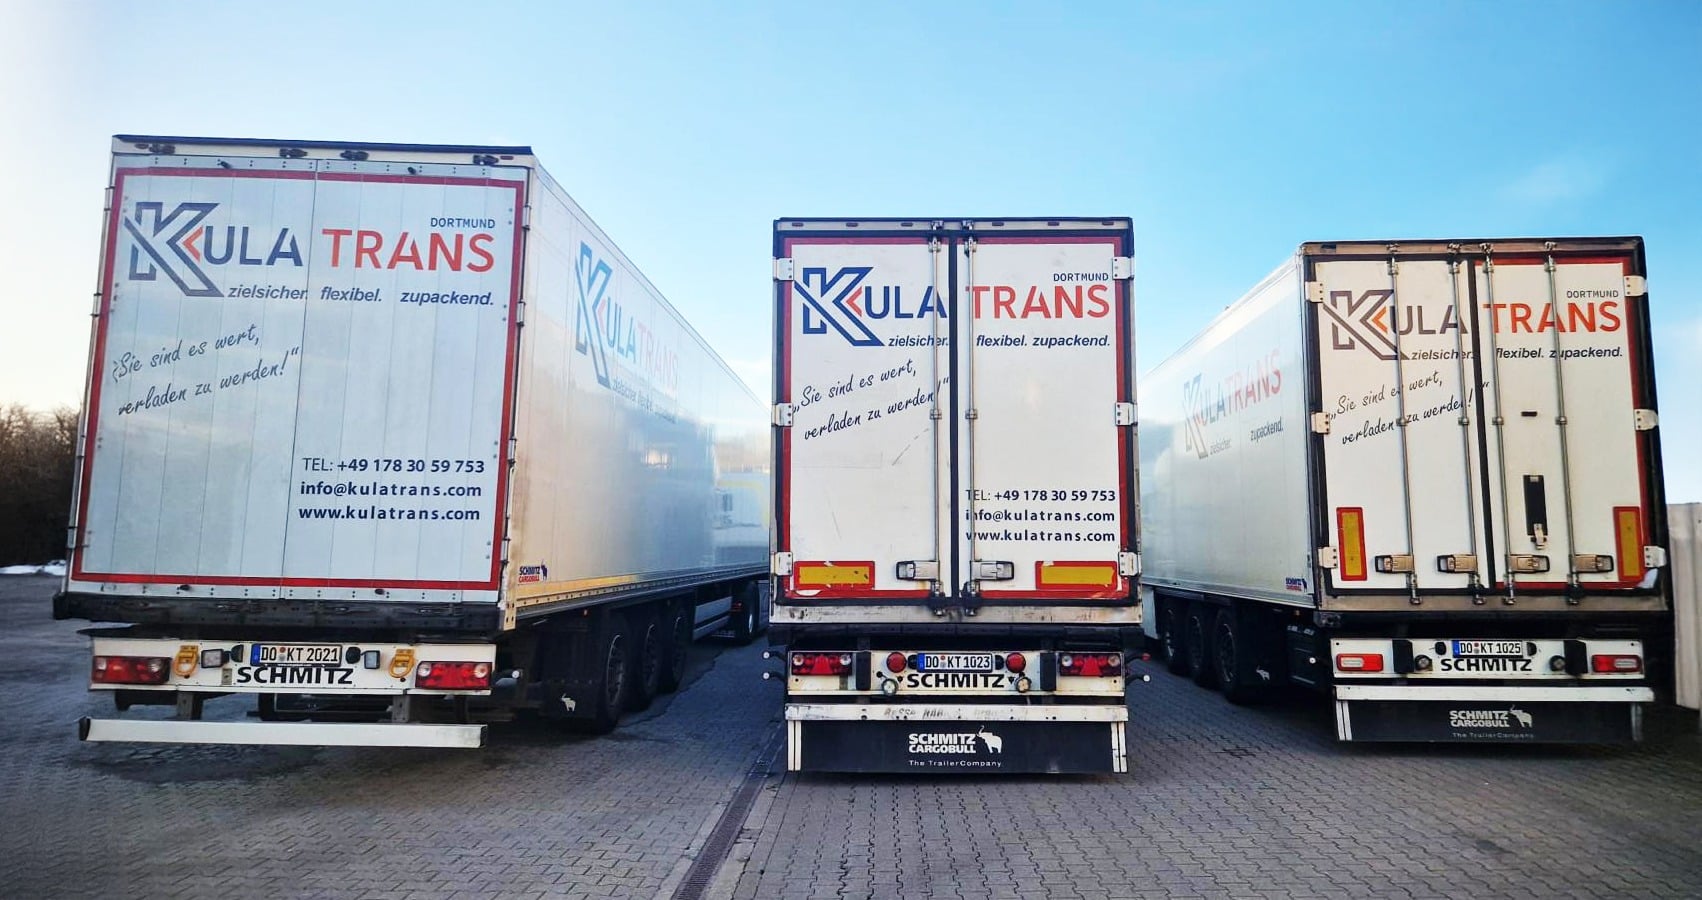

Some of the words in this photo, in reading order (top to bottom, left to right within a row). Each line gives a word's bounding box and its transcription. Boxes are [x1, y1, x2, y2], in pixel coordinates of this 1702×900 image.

[430, 216, 496, 229] DORTMUND
[321, 228, 495, 272] TRANS
[1053, 272, 1109, 282] DORTMUND
[228, 285, 308, 300] zielsicher.
[321, 285, 382, 302] flexibel.
[400, 289, 494, 306] zupackend.
[965, 284, 1110, 319] TRANS
[1566, 290, 1619, 299] DORTMUND
[1483, 301, 1621, 334] TRANS
[150, 339, 183, 368] sind
[188, 340, 208, 357] es
[215, 323, 260, 350] wert,
[888, 335, 949, 347] zielsicher.
[976, 334, 1028, 347] flexibel.
[1032, 334, 1110, 348] zupackend.
[1496, 347, 1544, 359] flexibel.
[828, 374, 854, 398] sind
[859, 374, 874, 388] es
[880, 358, 916, 381] wert,
[1362, 384, 1385, 407] sind
[1390, 384, 1404, 397] e
[1409, 369, 1443, 391] wert,
[118, 383, 188, 416] verladen
[195, 383, 213, 396] zu
[804, 410, 861, 440] verladen
[867, 408, 882, 421] zu
[1342, 417, 1395, 445] verladen
[1405, 414, 1418, 424] zu
[302, 457, 334, 472] TEL:
[337, 458, 368, 473] +49
[373, 458, 402, 473] 178
[407, 459, 426, 473] 30
[431, 459, 451, 473] 59
[455, 460, 485, 474] 753
[300, 480, 482, 498] info@kulatrans.com
[965, 489, 991, 501] TEL:
[994, 490, 1020, 501] +49
[1024, 490, 1048, 501] 178
[1051, 490, 1067, 501] 30
[1071, 490, 1088, 501] 59
[1091, 490, 1116, 501] 753
[298, 505, 480, 520] www.kulatrans.com
[965, 509, 1115, 522] info@kulatrans.com
[965, 529, 1116, 541] www.kulatrans.com
[261, 646, 278, 661] DO
[287, 647, 303, 661] KT
[307, 647, 338, 662] 2021
[1460, 642, 1472, 654] DO
[1480, 642, 1494, 654] KT
[1496, 641, 1521, 654] 1025
[926, 654, 939, 668] DO
[947, 655, 962, 668] KT
[963, 654, 990, 668] 1023
[1440, 658, 1532, 672] SCHMITZ
[236, 666, 354, 685] SCHMITZ
[906, 673, 1005, 689] SCHMITZ
[1449, 710, 1509, 720] SCHMITZ
[1450, 719, 1510, 727] CARGOBULL
[908, 733, 976, 744] SCHMITZ
[908, 744, 976, 754] CARGOBULL
